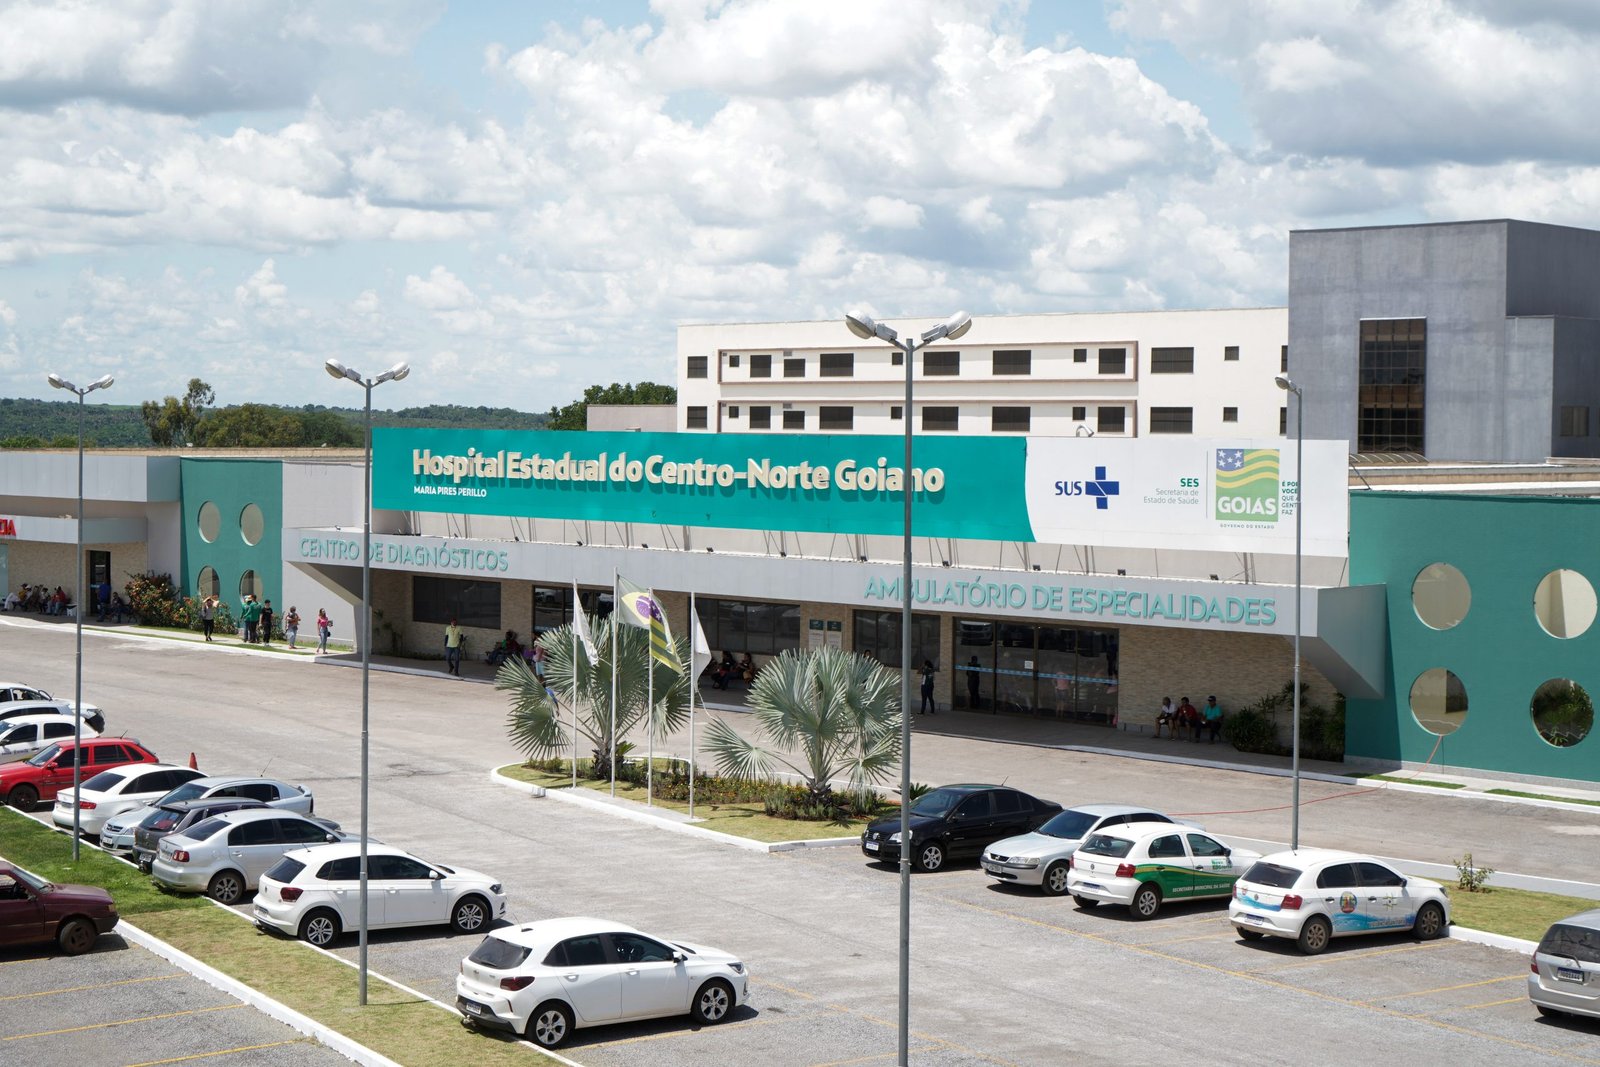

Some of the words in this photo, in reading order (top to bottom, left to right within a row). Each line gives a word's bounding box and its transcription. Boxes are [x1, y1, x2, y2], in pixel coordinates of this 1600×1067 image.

[413, 447, 505, 483] Hospital
[506, 451, 607, 480] Estadual
[609, 452, 643, 482] do
[645, 454, 830, 489] Centro-Norte
[834, 457, 945, 492] Goiano
[1055, 481, 1082, 496] SUS
[1180, 478, 1199, 487] SES
[414, 486, 437, 495] MARIA
[437, 487, 457, 496] PIRES
[458, 488, 487, 497] PERILLO
[1190, 488, 1199, 496] de
[1143, 496, 1166, 504] Estado
[1167, 496, 1176, 505] de
[1177, 496, 1199, 505] Saúde
[300, 538, 360, 560] CENTRO
[388, 542, 509, 572] DIAGNÓSTICOS
[1032, 585, 1064, 612] DE
[1068, 587, 1277, 625] ESPECIALIDADES
